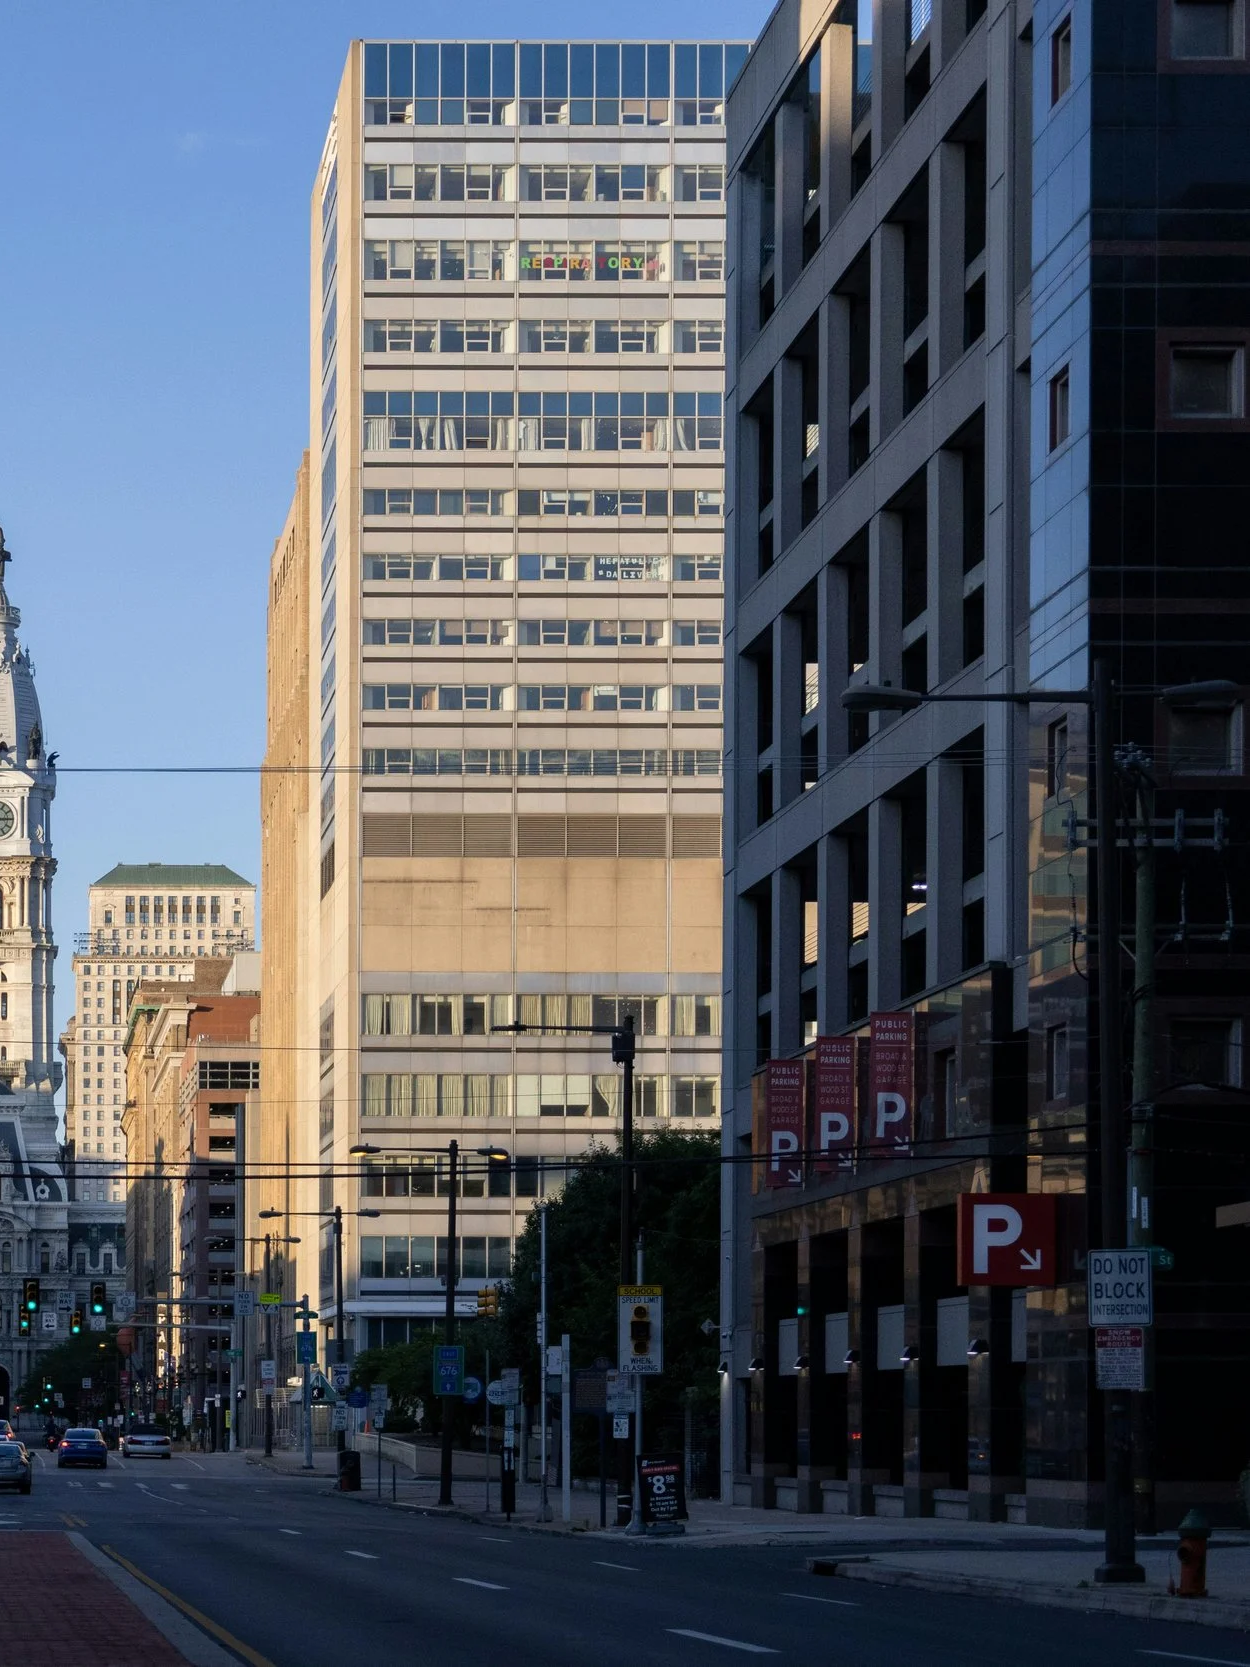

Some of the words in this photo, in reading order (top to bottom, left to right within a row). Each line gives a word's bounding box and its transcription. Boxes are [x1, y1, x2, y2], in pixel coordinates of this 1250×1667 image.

[875, 1032, 907, 1040] PARKING
[820, 1044, 850, 1052] PUBLIC
[820, 1056, 850, 1064] PARKING
[876, 1052, 900, 1060] BROAD
[771, 1067, 799, 1075] PUBLIC
[876, 1064, 896, 1072] WOOD
[771, 1078, 799, 1086] PARKING
[821, 1075, 843, 1083] BROAD
[875, 1076, 907, 1084] GARAGE
[772, 1106, 790, 1114] WOOD
[876, 1092, 906, 1137] P
[771, 1116, 799, 1124] GARAGE
[820, 1112, 850, 1155] P
[771, 1130, 799, 1171] P
[973, 1204, 1022, 1274] P
[1159, 1256, 1172, 1264] St
[1094, 1258, 1112, 1274] DO
[1118, 1257, 1145, 1274] NOT
[1094, 1282, 1146, 1299] BLOCK
[622, 1296, 642, 1304] SPEED
[644, 1296, 660, 1304] LIMIT
[1094, 1304, 1148, 1316] INTERSECTION
[440, 1366, 458, 1376] 676
